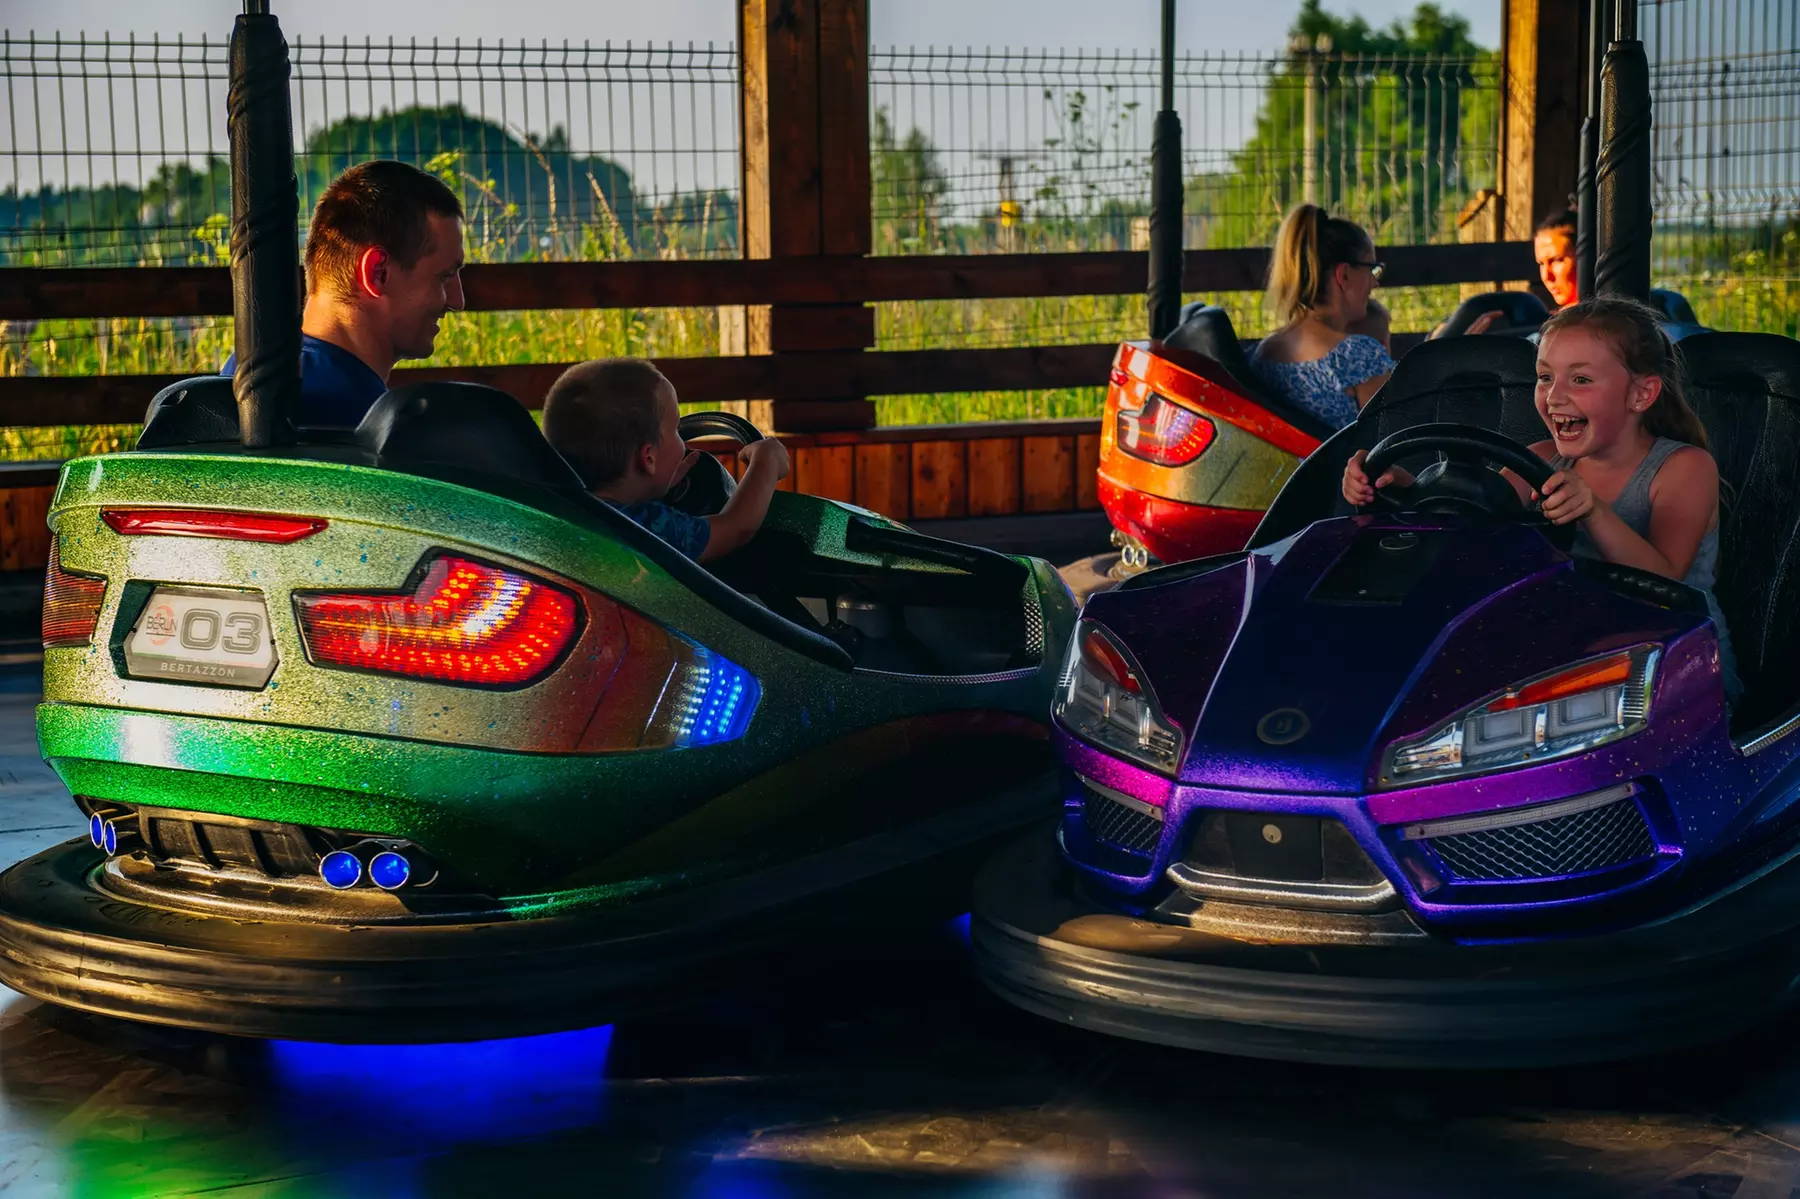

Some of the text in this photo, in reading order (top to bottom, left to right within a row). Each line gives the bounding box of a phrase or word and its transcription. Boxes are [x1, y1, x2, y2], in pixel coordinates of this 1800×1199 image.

[146, 616, 178, 631] BERLIN
[180, 608, 264, 655] 03
[160, 662, 236, 678] BERTAZZON
